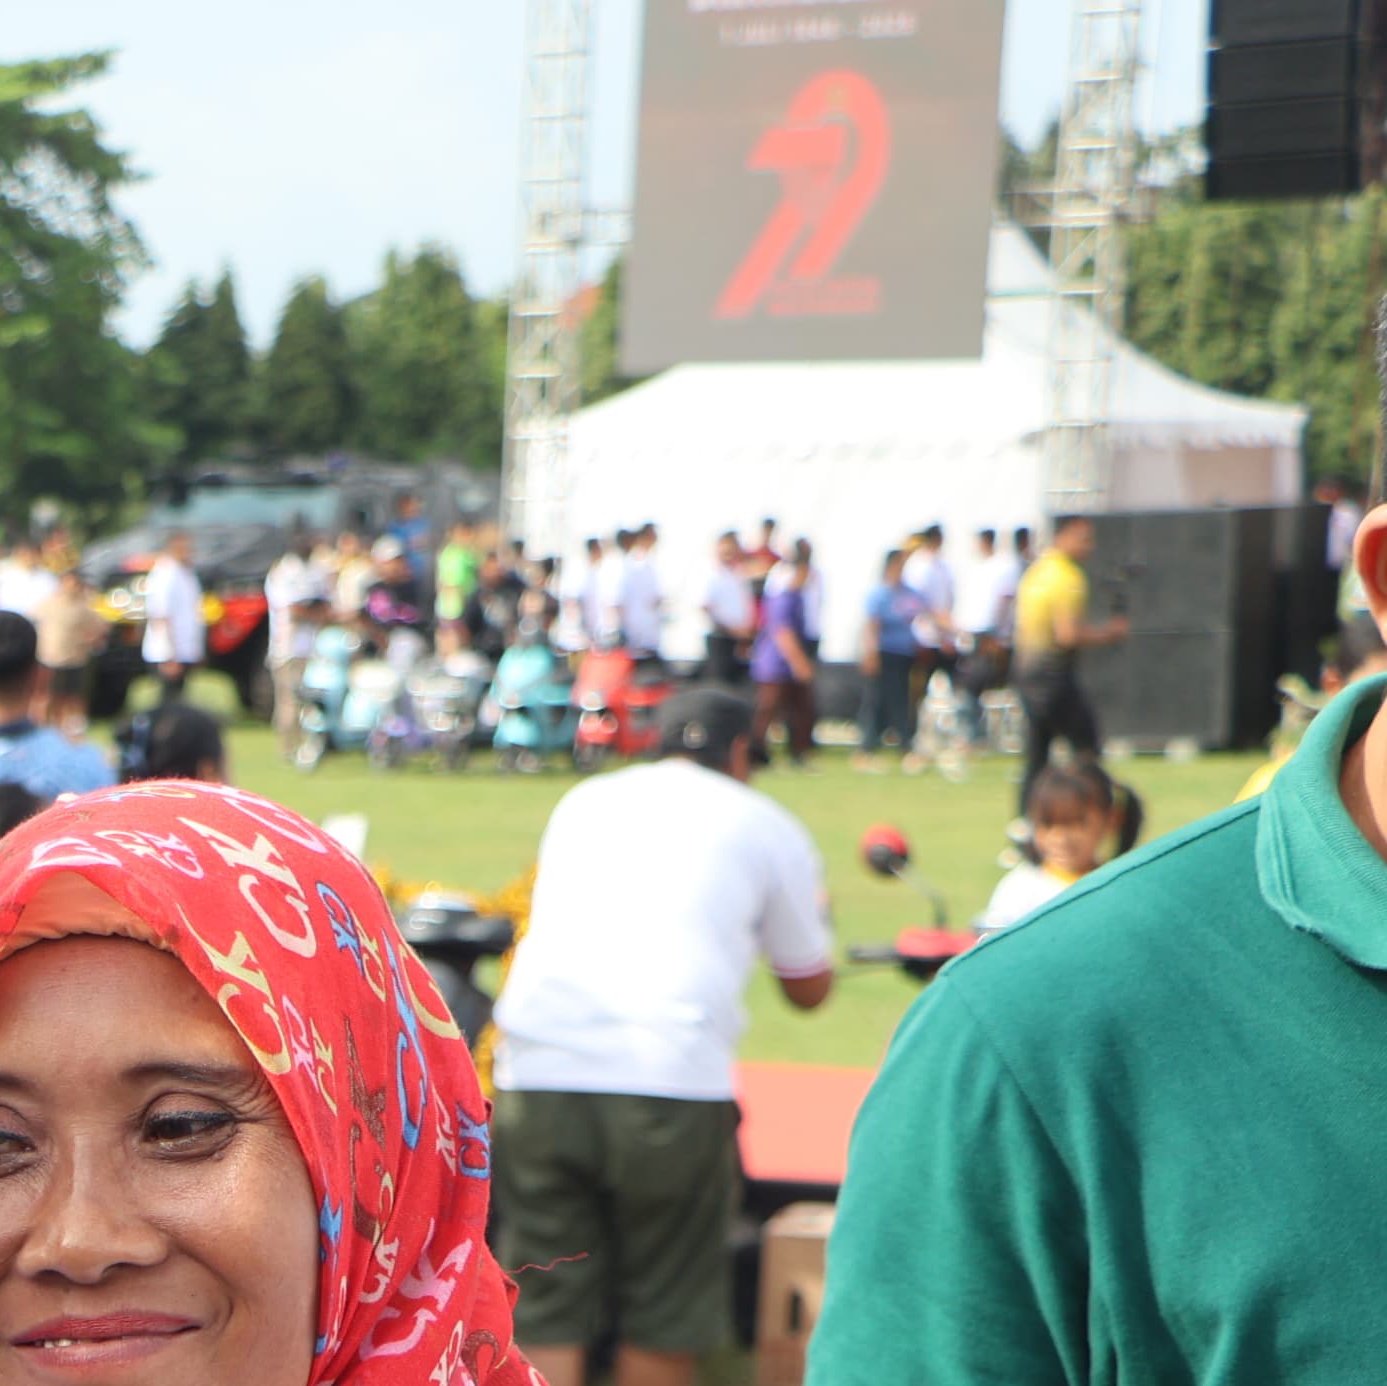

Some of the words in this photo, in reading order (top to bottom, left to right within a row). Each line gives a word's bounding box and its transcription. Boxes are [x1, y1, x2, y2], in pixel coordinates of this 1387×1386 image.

[176, 816, 318, 959] CK
[175, 901, 292, 1076] CK
[456, 1102, 492, 1180] CK
